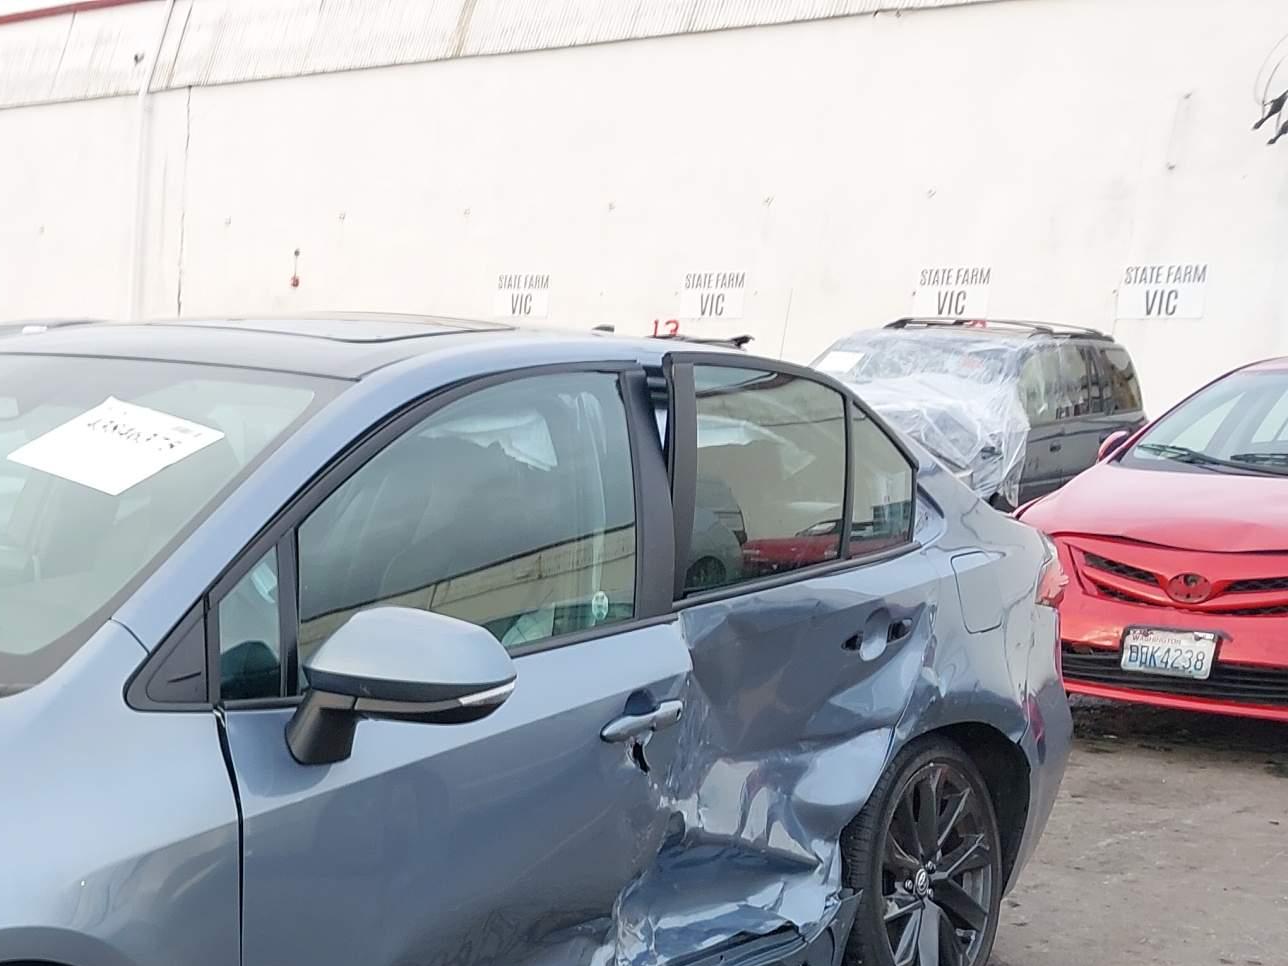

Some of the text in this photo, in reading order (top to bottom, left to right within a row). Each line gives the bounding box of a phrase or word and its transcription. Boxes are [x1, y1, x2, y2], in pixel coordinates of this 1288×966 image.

[498, 273, 550, 290] STATE FARM
[685, 272, 745, 289] STATE FARM
[920, 266, 991, 286] STATE FARM
[1124, 264, 1208, 285] STATE FARM
[511, 293, 533, 316] VIC
[700, 293, 725, 316] VIC
[936, 290, 967, 316] VIC
[1145, 289, 1178, 316] VIC
